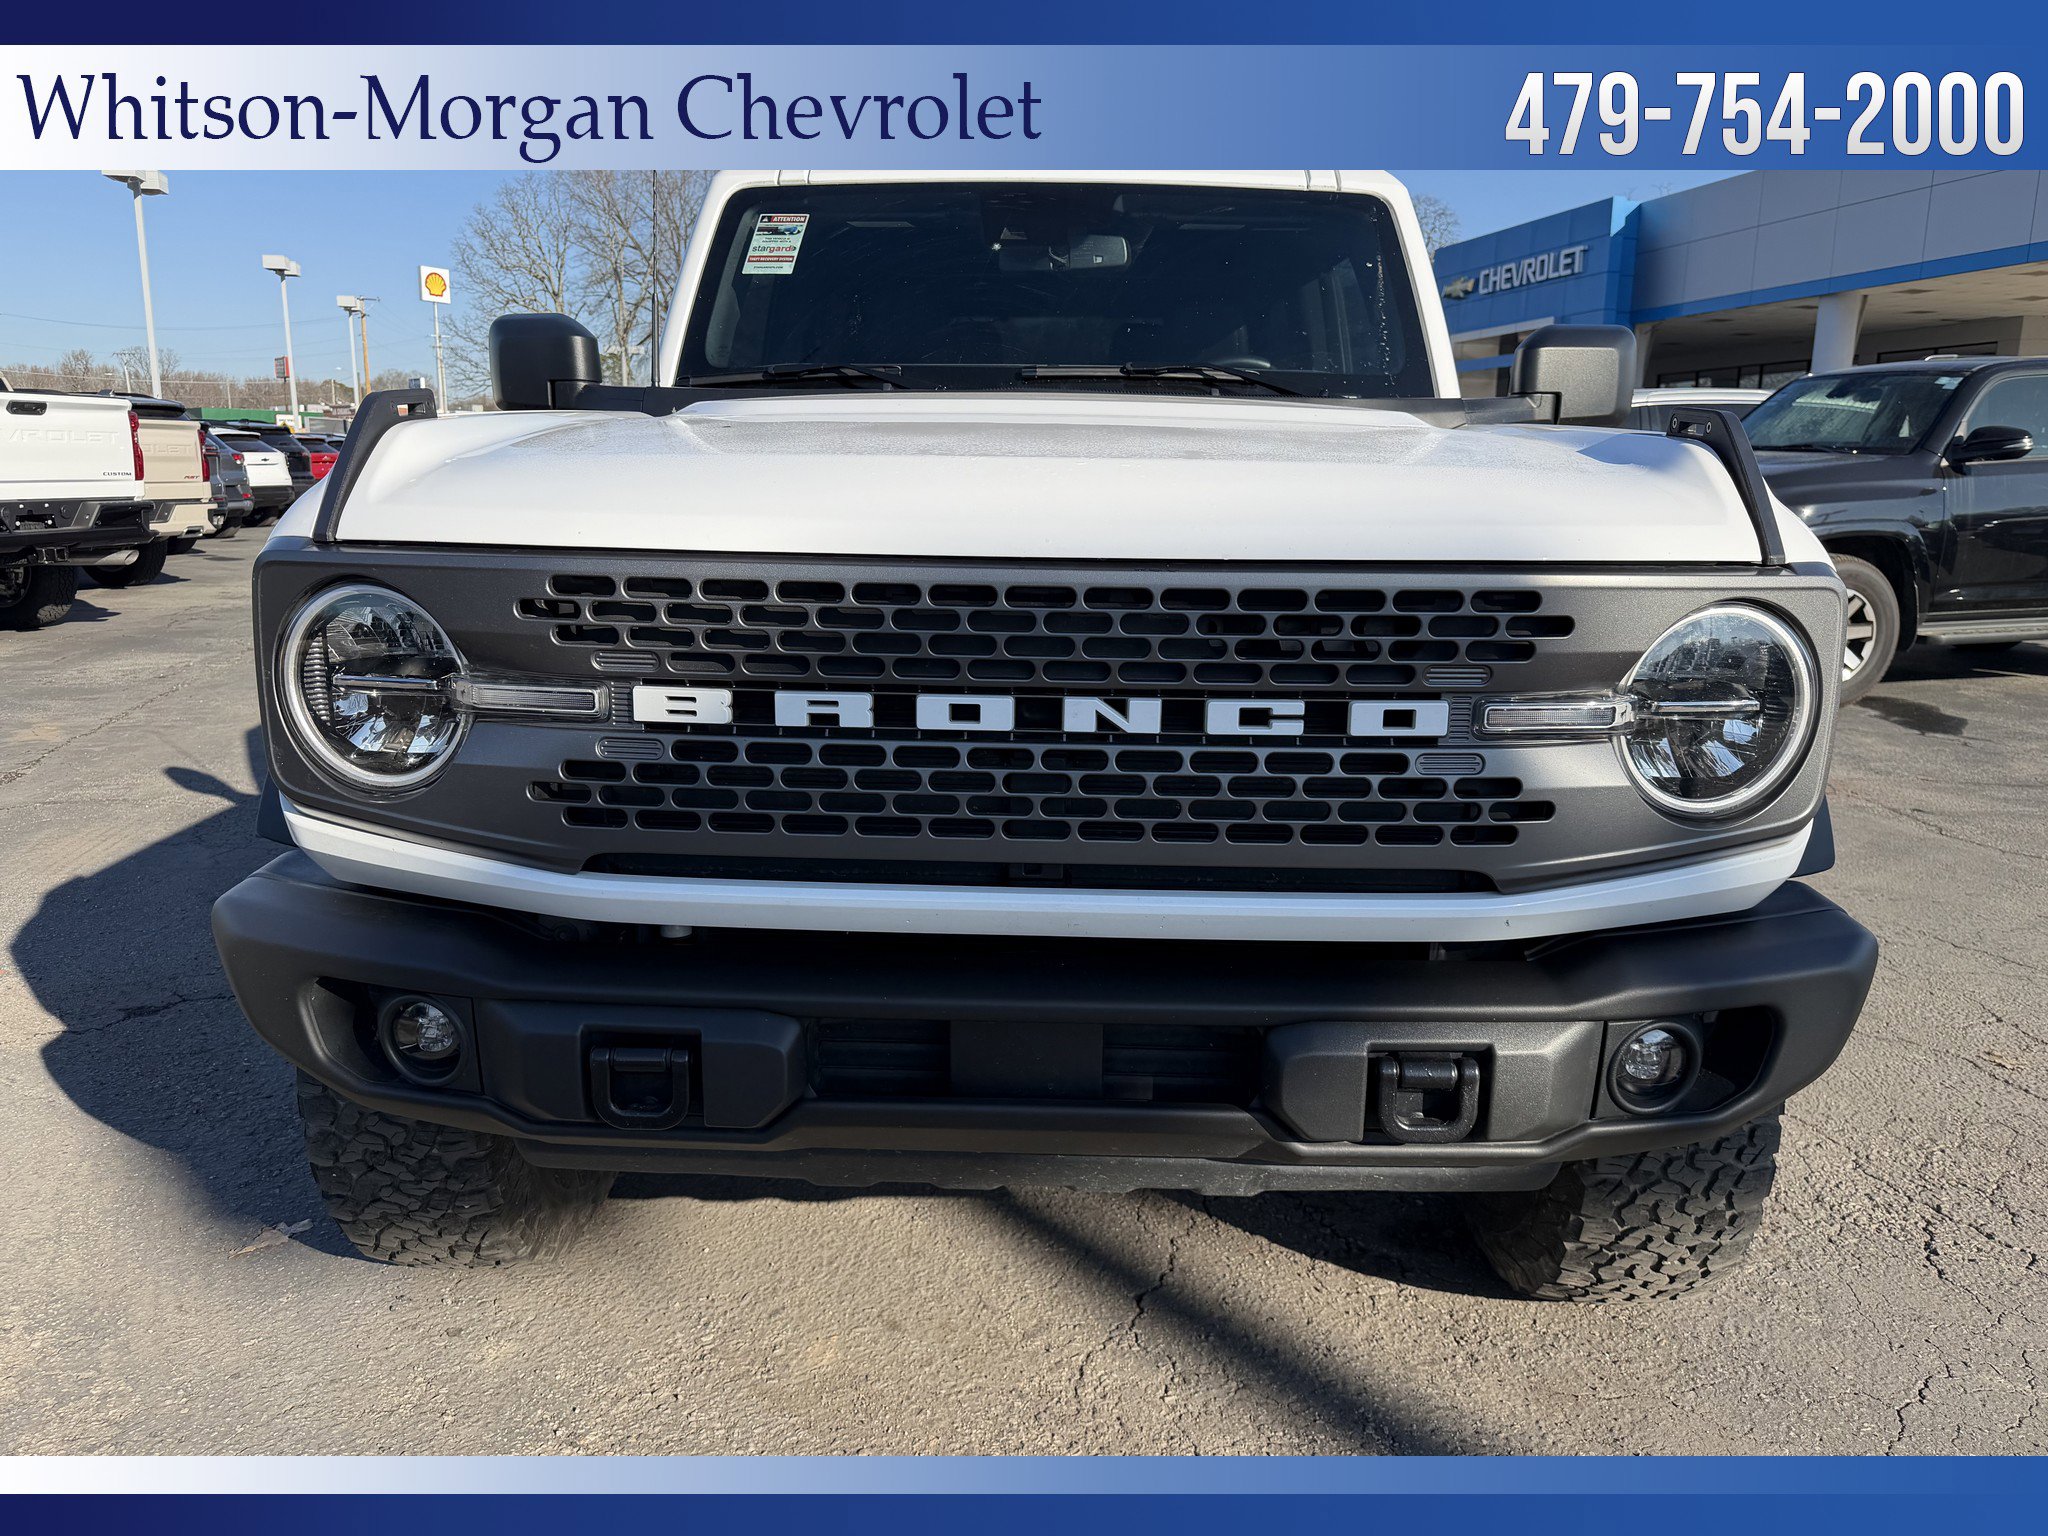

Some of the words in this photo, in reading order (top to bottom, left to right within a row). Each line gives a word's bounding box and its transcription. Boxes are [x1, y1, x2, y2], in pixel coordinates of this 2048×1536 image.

[752, 245, 792, 253] stargard
[1478, 246, 1587, 295] CHEVROLET
[632, 685, 1450, 738] BRONCO
